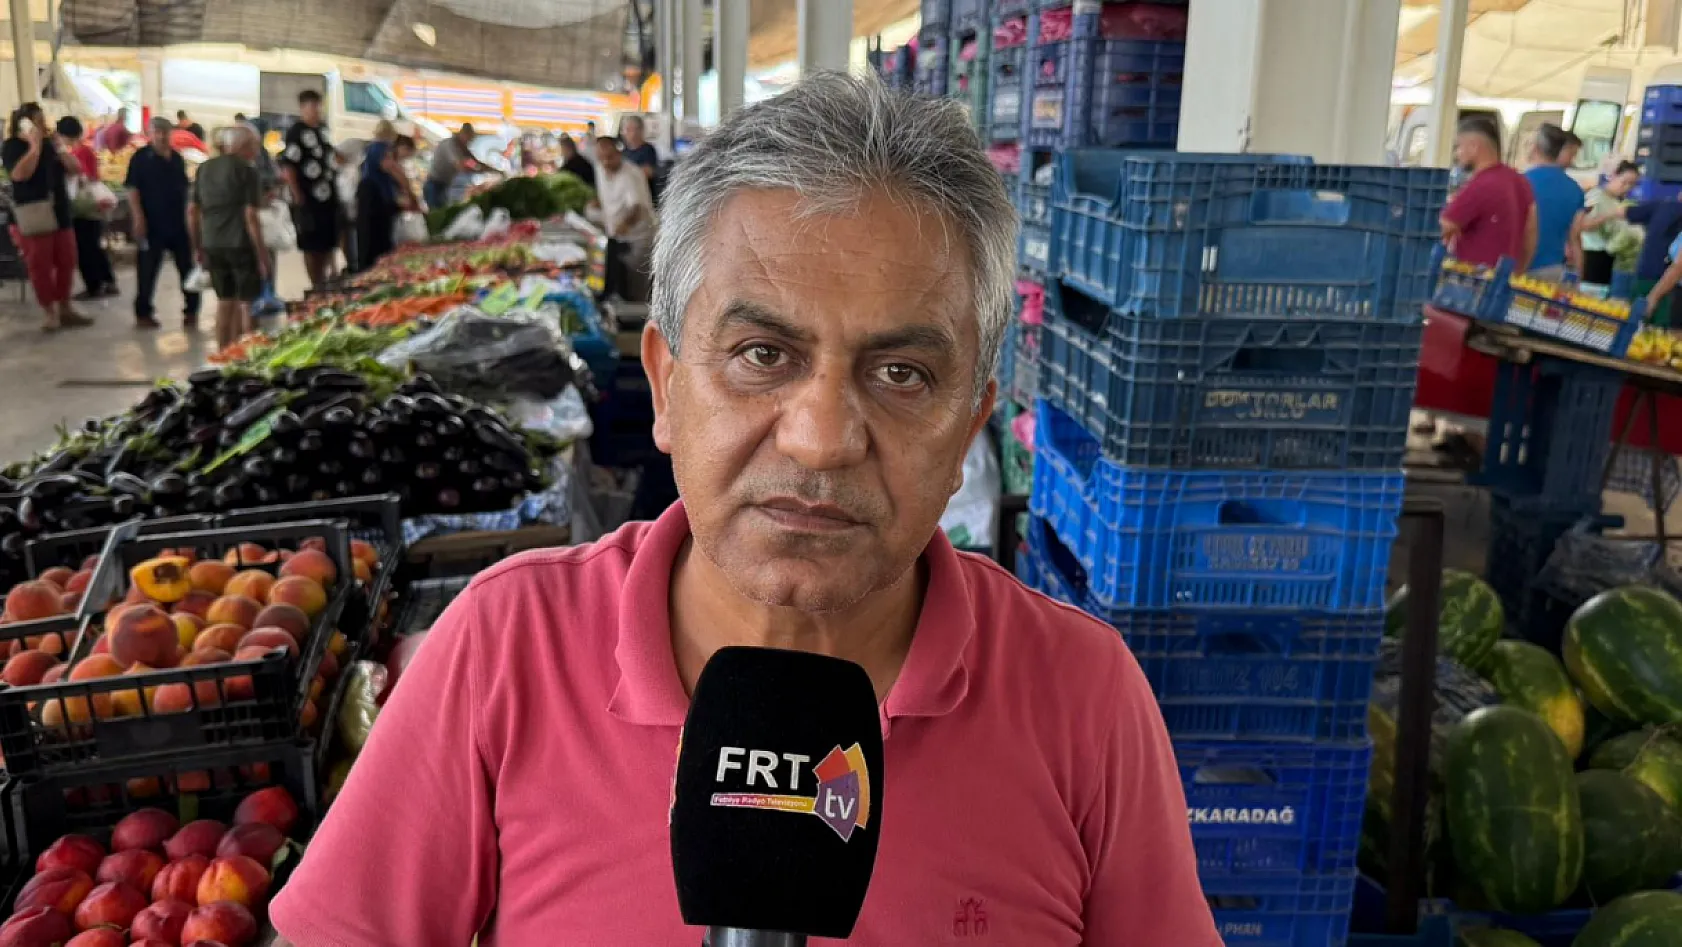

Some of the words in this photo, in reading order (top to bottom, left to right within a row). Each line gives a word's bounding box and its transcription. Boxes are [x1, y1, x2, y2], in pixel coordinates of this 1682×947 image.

[716, 746, 811, 790] FRT
[824, 787, 855, 820] tv
[1186, 805, 1296, 825] ZKARADAĞ
